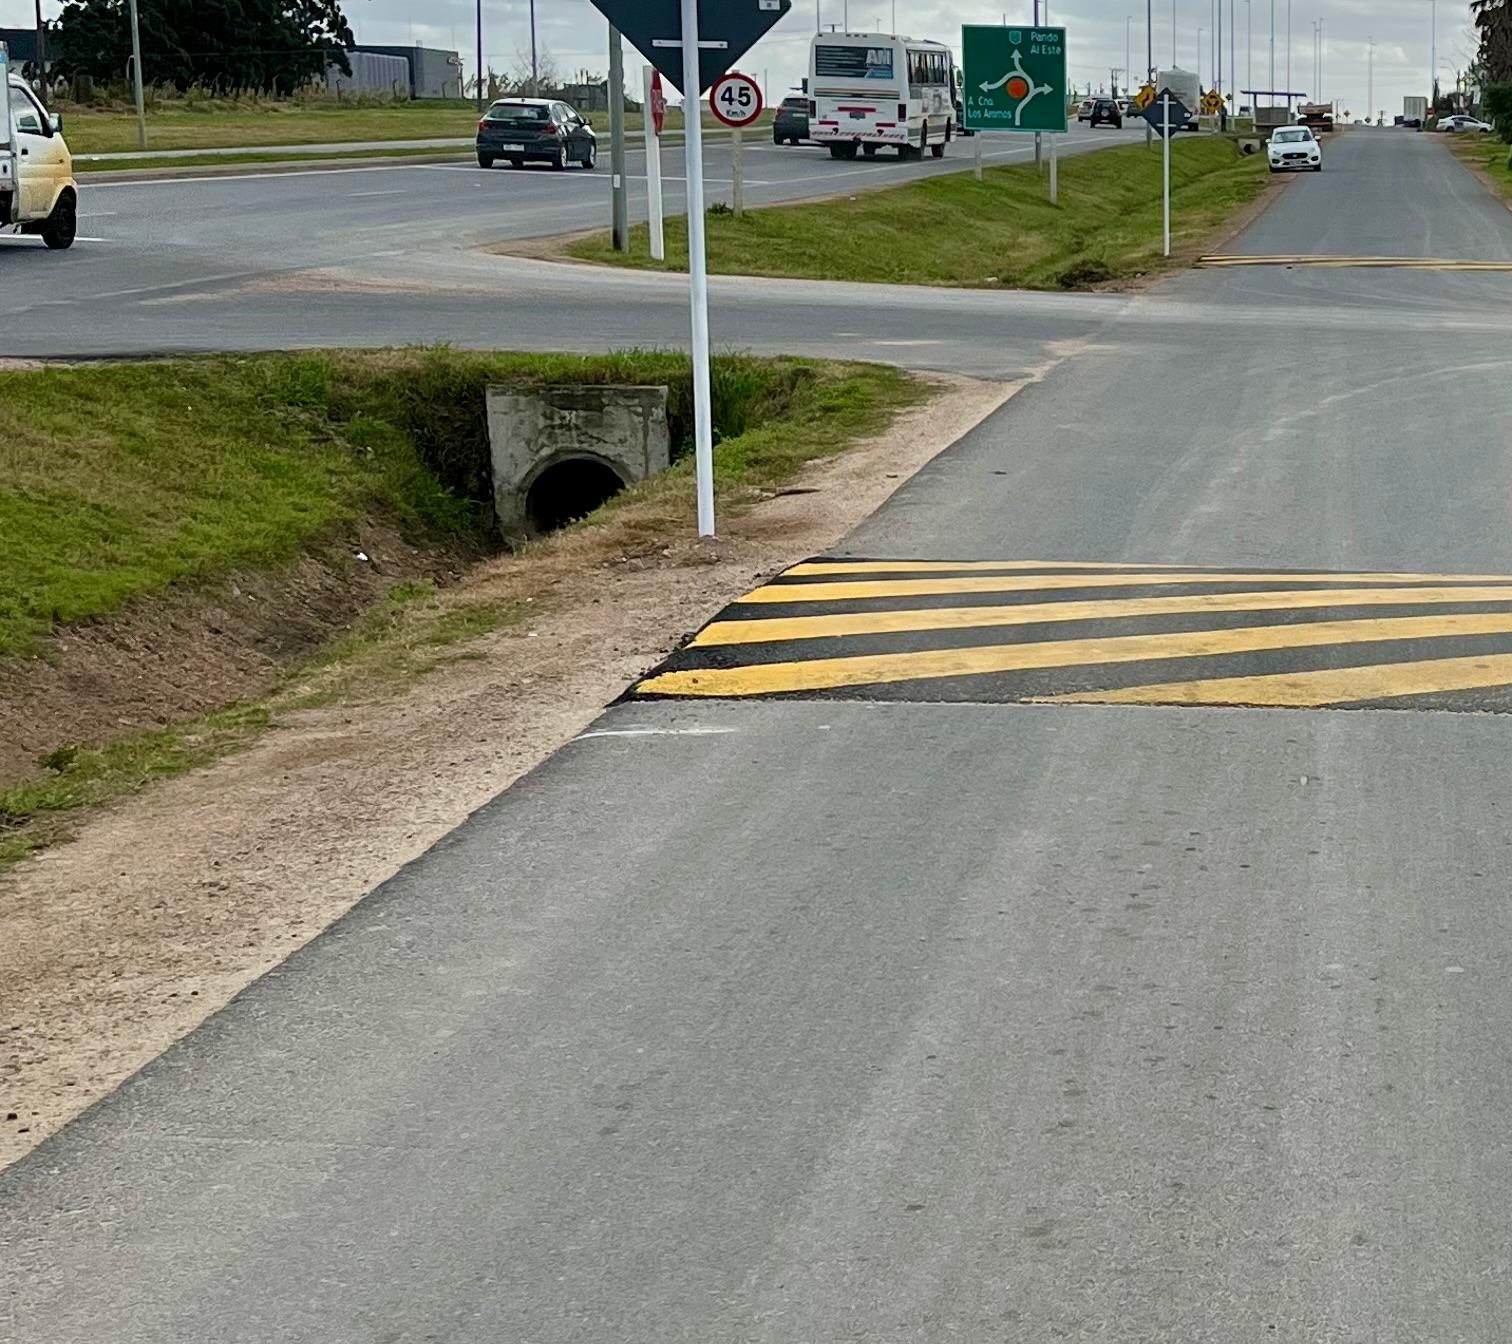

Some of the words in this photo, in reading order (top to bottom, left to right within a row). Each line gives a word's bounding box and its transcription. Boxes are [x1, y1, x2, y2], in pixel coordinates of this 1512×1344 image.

[1030, 31, 1059, 42] Pando
[1030, 44, 1040, 55] Al
[1041, 44, 1062, 55] Este
[720, 86, 751, 107] 45
[967, 107, 982, 119] Los
[983, 108, 1012, 119] Aromos
